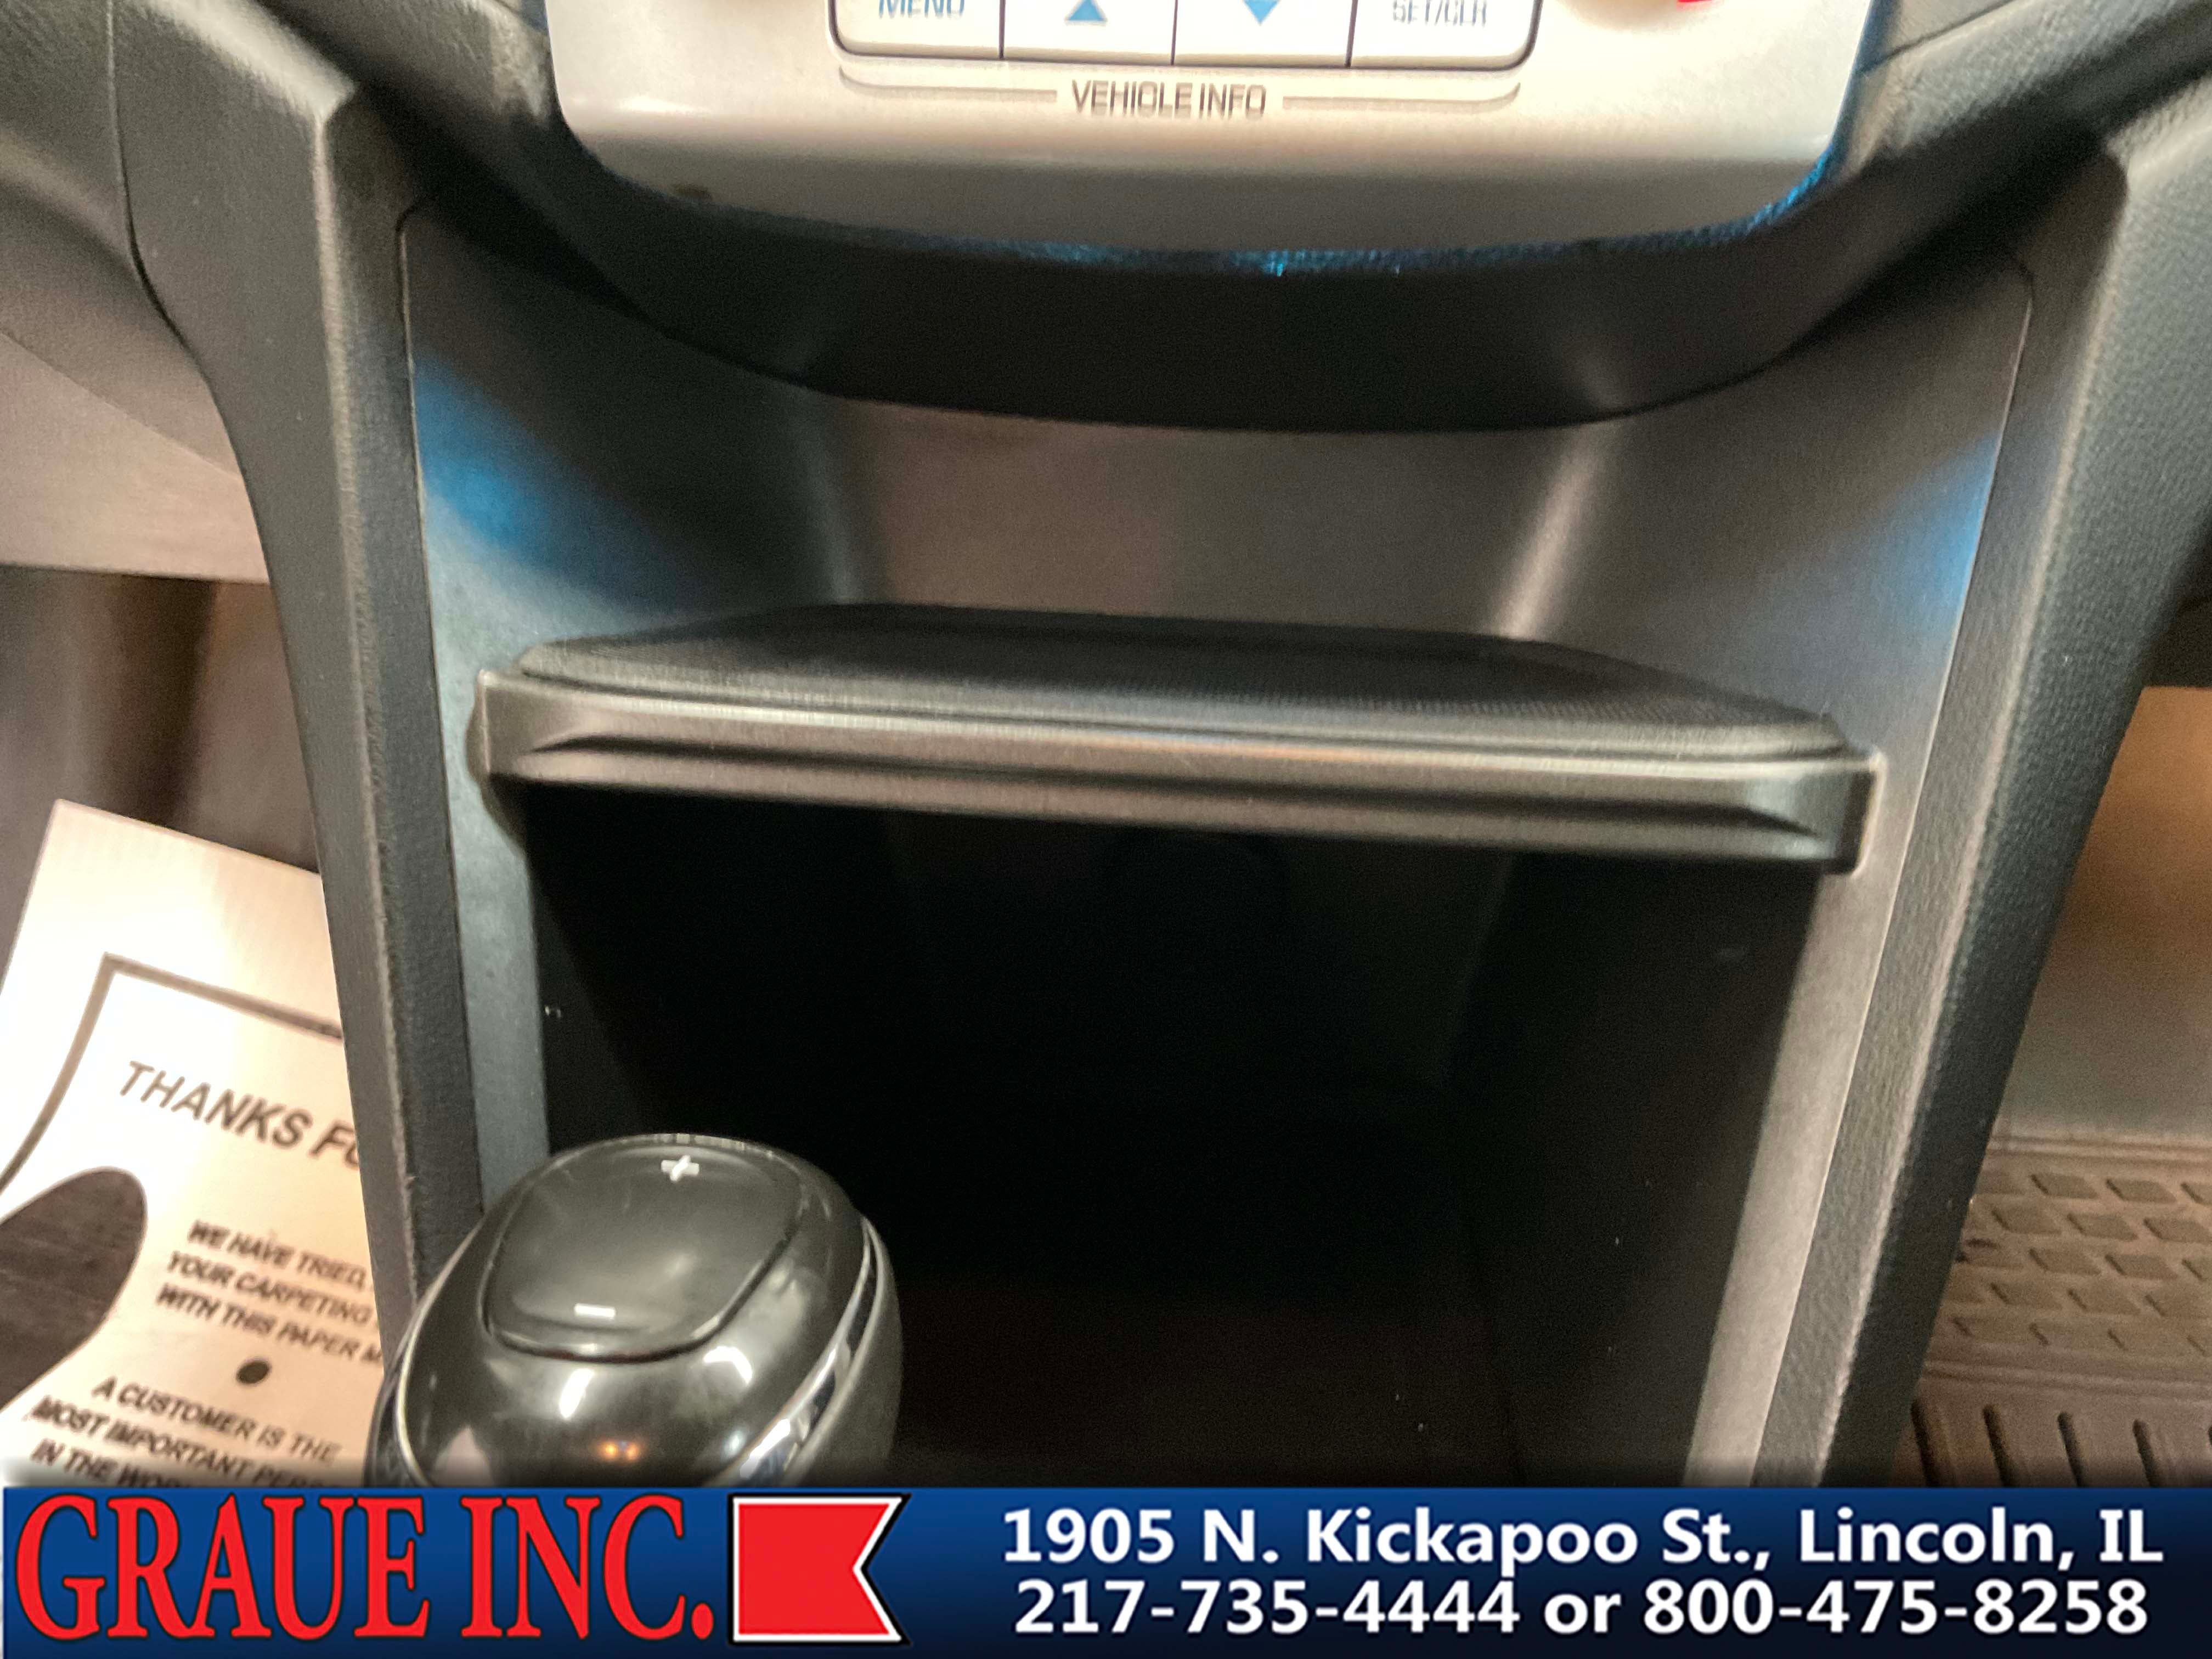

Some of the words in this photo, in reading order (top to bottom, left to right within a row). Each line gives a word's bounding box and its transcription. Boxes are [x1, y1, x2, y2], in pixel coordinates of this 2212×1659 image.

[1071, 79, 1193, 119] VEHICLE
[1199, 82, 1267, 119] INFO
[119, 1060, 313, 1150] THANKS
[187, 1220, 230, 1249] WE
[226, 1231, 296, 1269] HAVE
[156, 1282, 222, 1321] WITH
[221, 1301, 276, 1335] THIS
[277, 1321, 361, 1360] PAPER
[167, 1251, 235, 1287] YOUR
[236, 1272, 375, 1324] CARPETING
[31, 1395, 111, 1436] MOST
[103, 1419, 255, 1480] IMPORTANT
[91, 1375, 117, 1401] A
[116, 1383, 257, 1441] CUSTOMER
[257, 1425, 286, 1449] IS
[289, 1432, 342, 1465] THE
[31, 1438, 65, 1466] IN
[64, 1448, 119, 1481] THE
